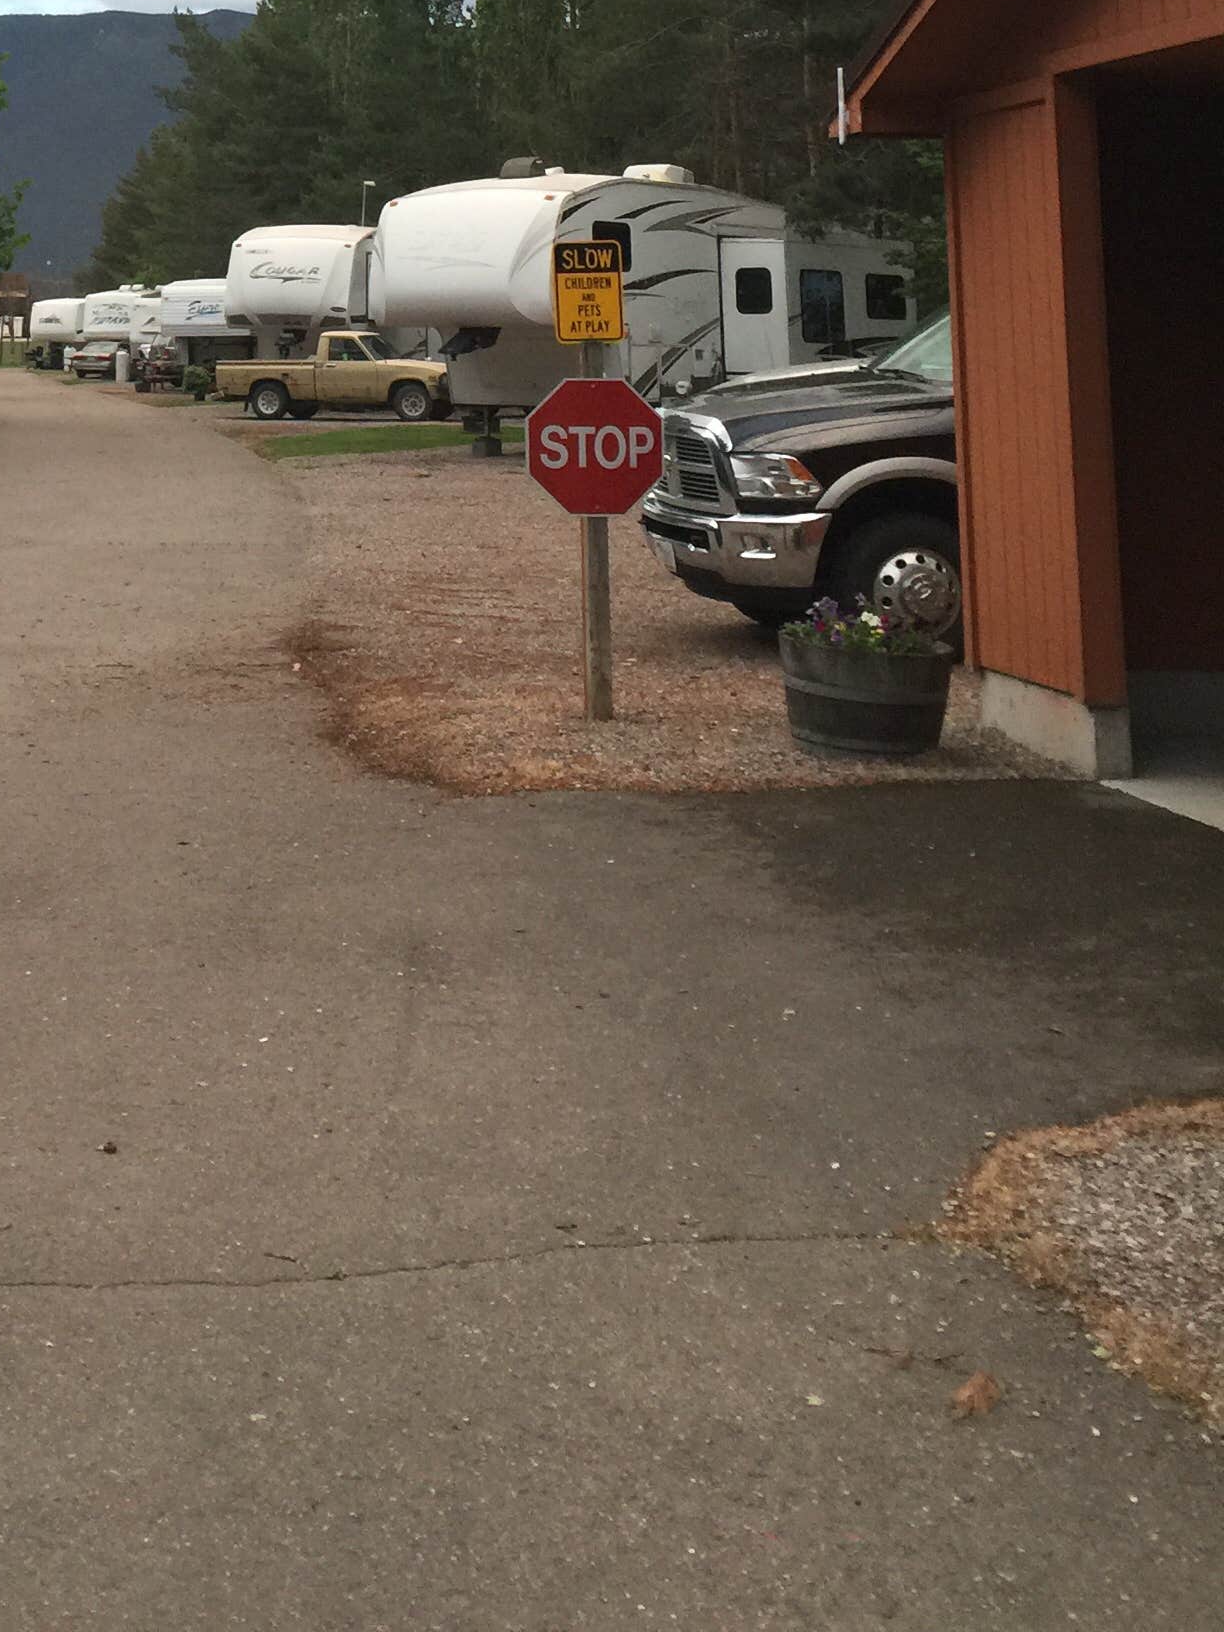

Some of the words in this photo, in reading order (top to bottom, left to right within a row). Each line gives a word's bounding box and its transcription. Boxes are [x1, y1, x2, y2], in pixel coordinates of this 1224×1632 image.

[561, 248, 613, 269] SLOW
[564, 277, 612, 289] CHILDREN
[582, 292, 596, 302] AND
[577, 304, 601, 317] PETS
[570, 320, 583, 333] AT
[585, 320, 610, 333] PLAY
[539, 424, 655, 469] STOP
